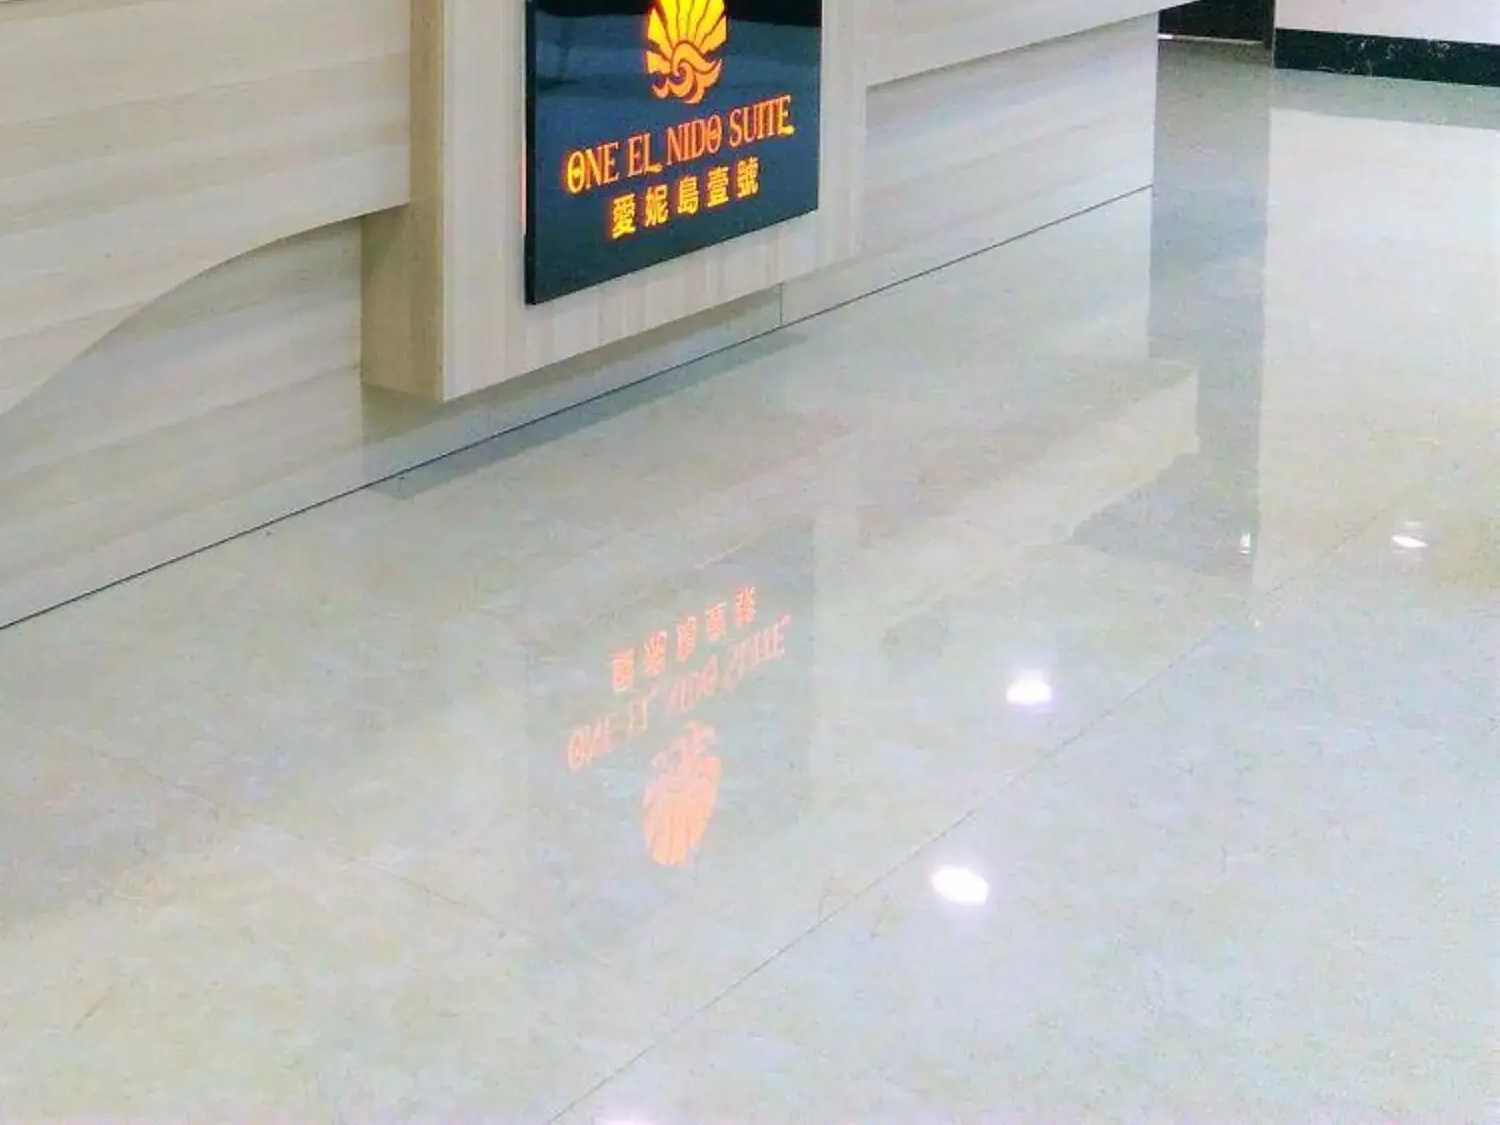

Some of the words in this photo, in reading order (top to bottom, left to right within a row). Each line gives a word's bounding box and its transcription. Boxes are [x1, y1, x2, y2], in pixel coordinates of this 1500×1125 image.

[566, 141, 620, 194] ONE
[628, 133, 663, 178] EL
[666, 114, 722, 166] NIDO
[729, 94, 797, 148] SUITE
